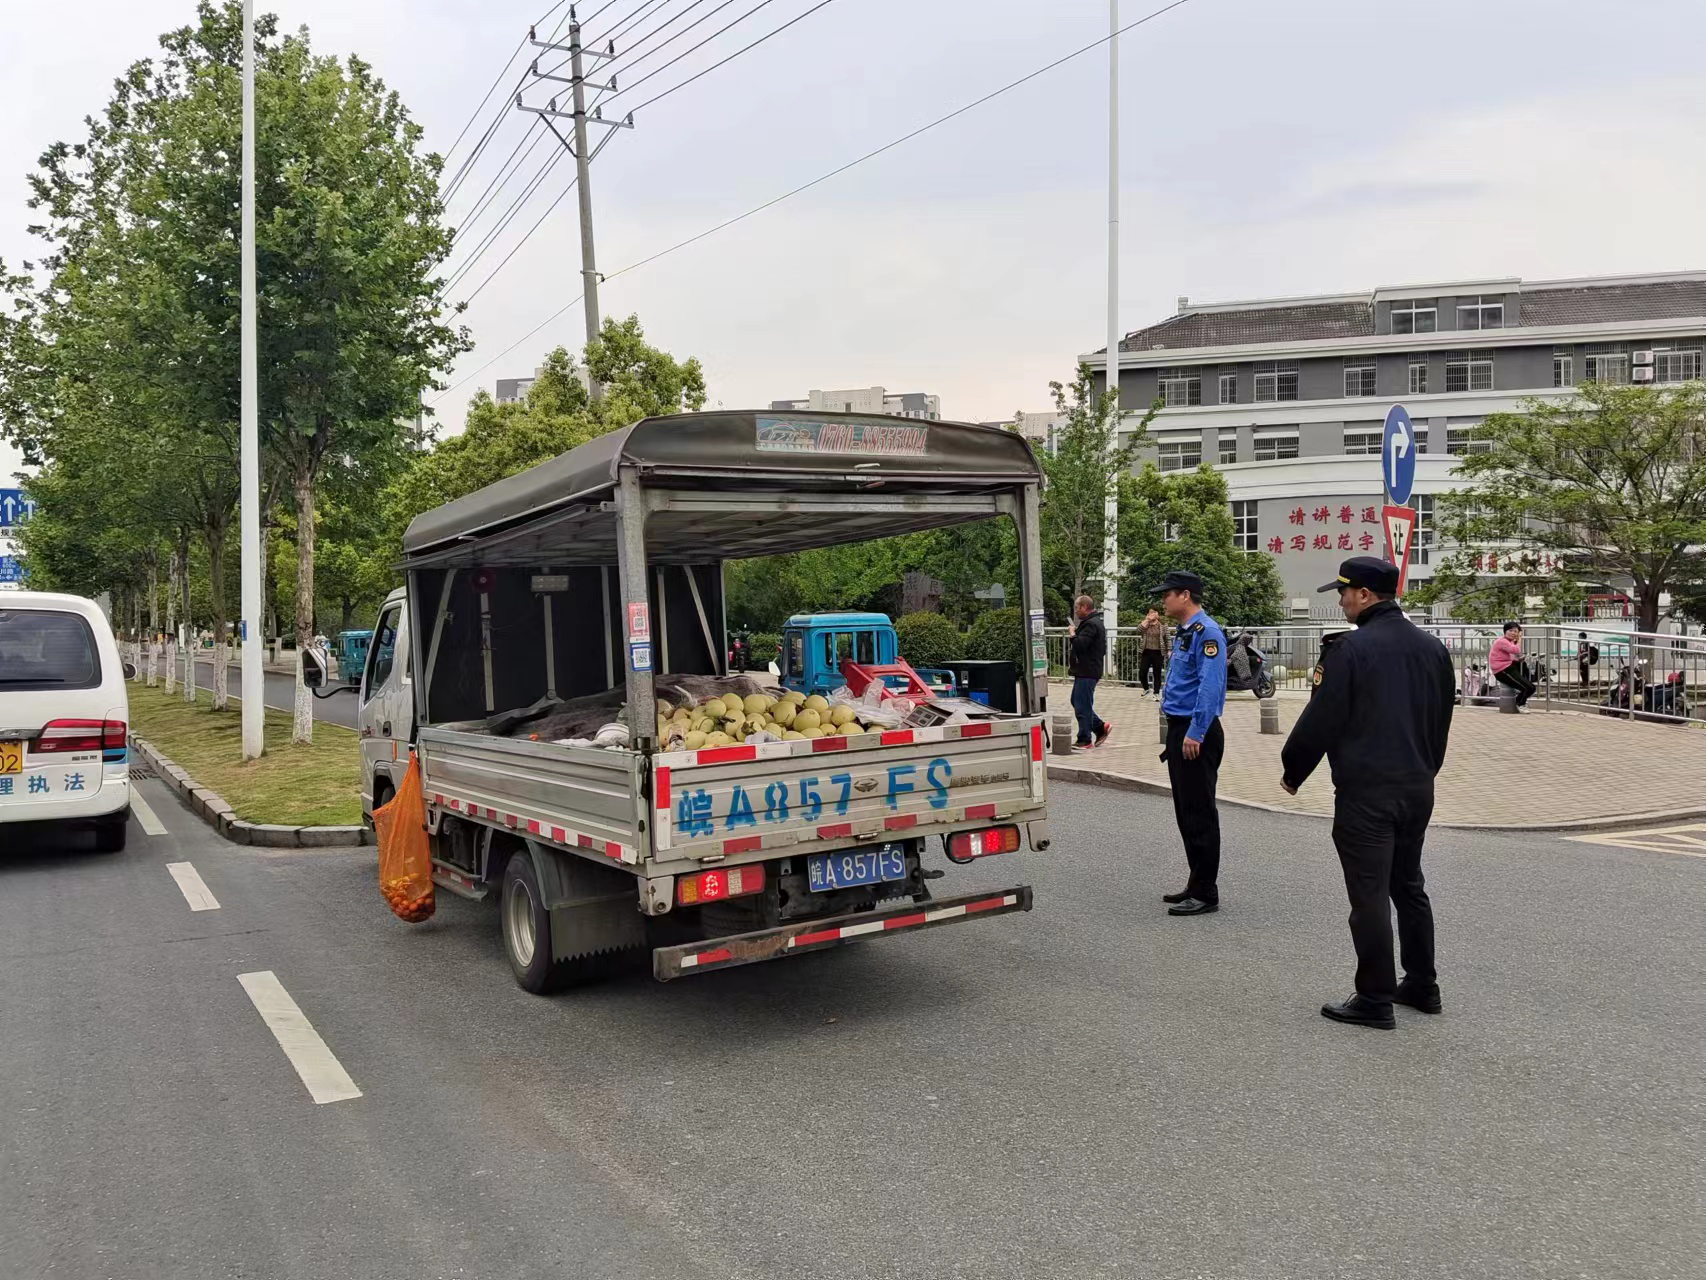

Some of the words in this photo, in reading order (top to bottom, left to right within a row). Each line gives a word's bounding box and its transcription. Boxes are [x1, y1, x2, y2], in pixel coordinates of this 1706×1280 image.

[1288, 505, 1381, 525] 请讲普通
[1267, 531, 1375, 553] 请写规范字
